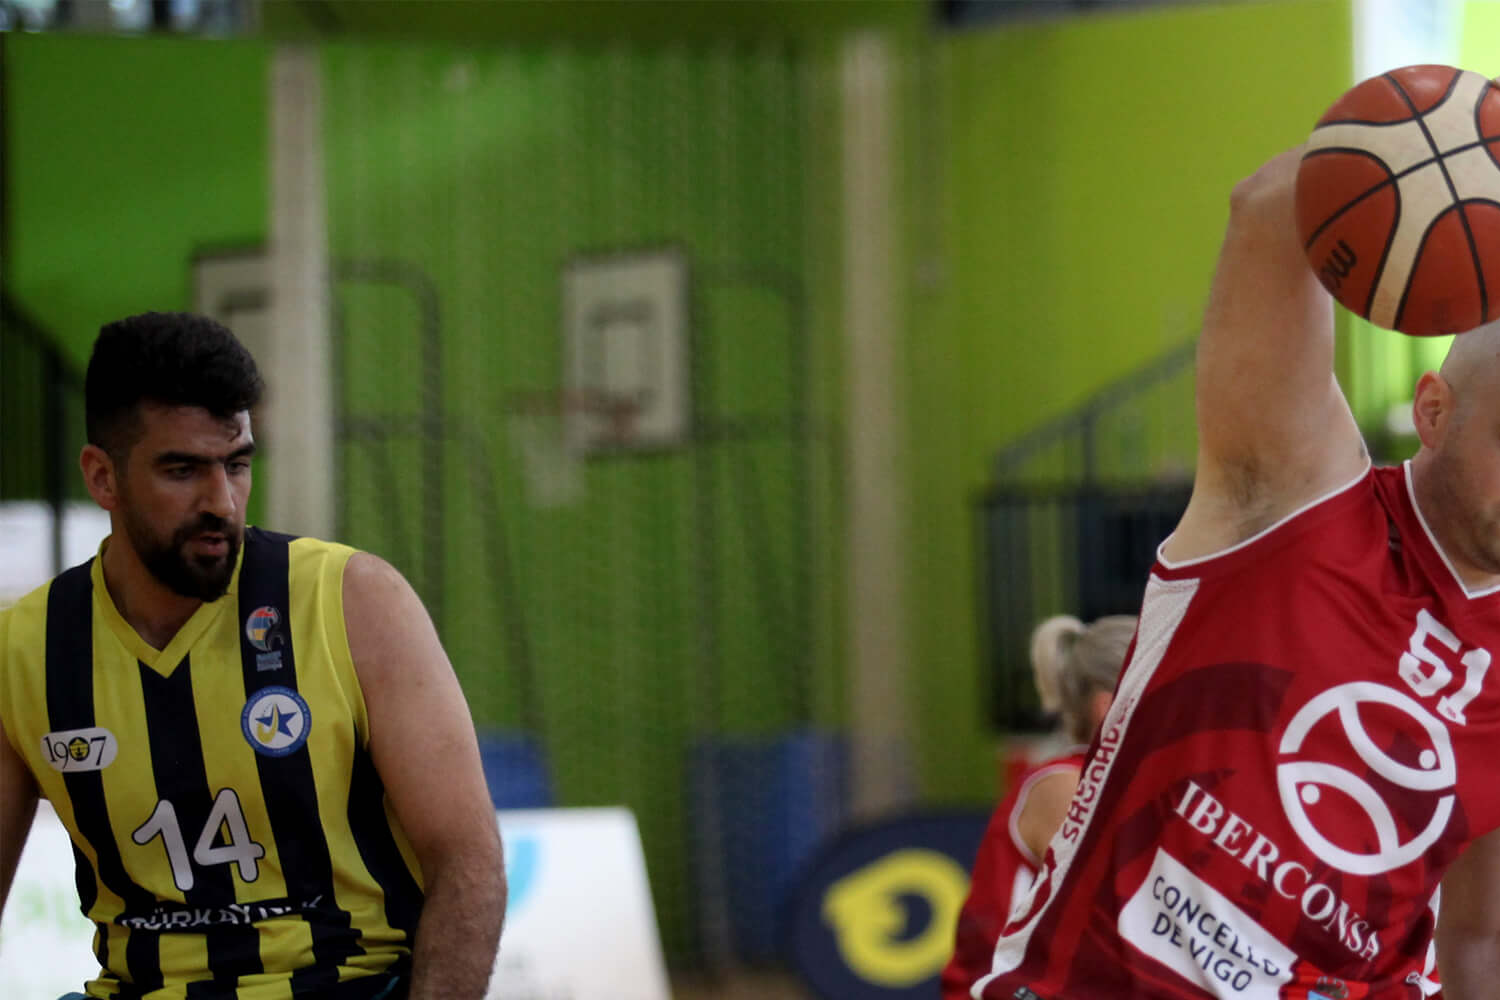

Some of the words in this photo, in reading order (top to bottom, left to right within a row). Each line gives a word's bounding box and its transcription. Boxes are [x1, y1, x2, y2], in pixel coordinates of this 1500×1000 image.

[1398, 608, 1492, 726] 51
[131, 787, 265, 891] 14
[1174, 779, 1380, 962] IBERCONSA
[1151, 912, 1184, 949] DE
[1187, 936, 1253, 992] VIGO
